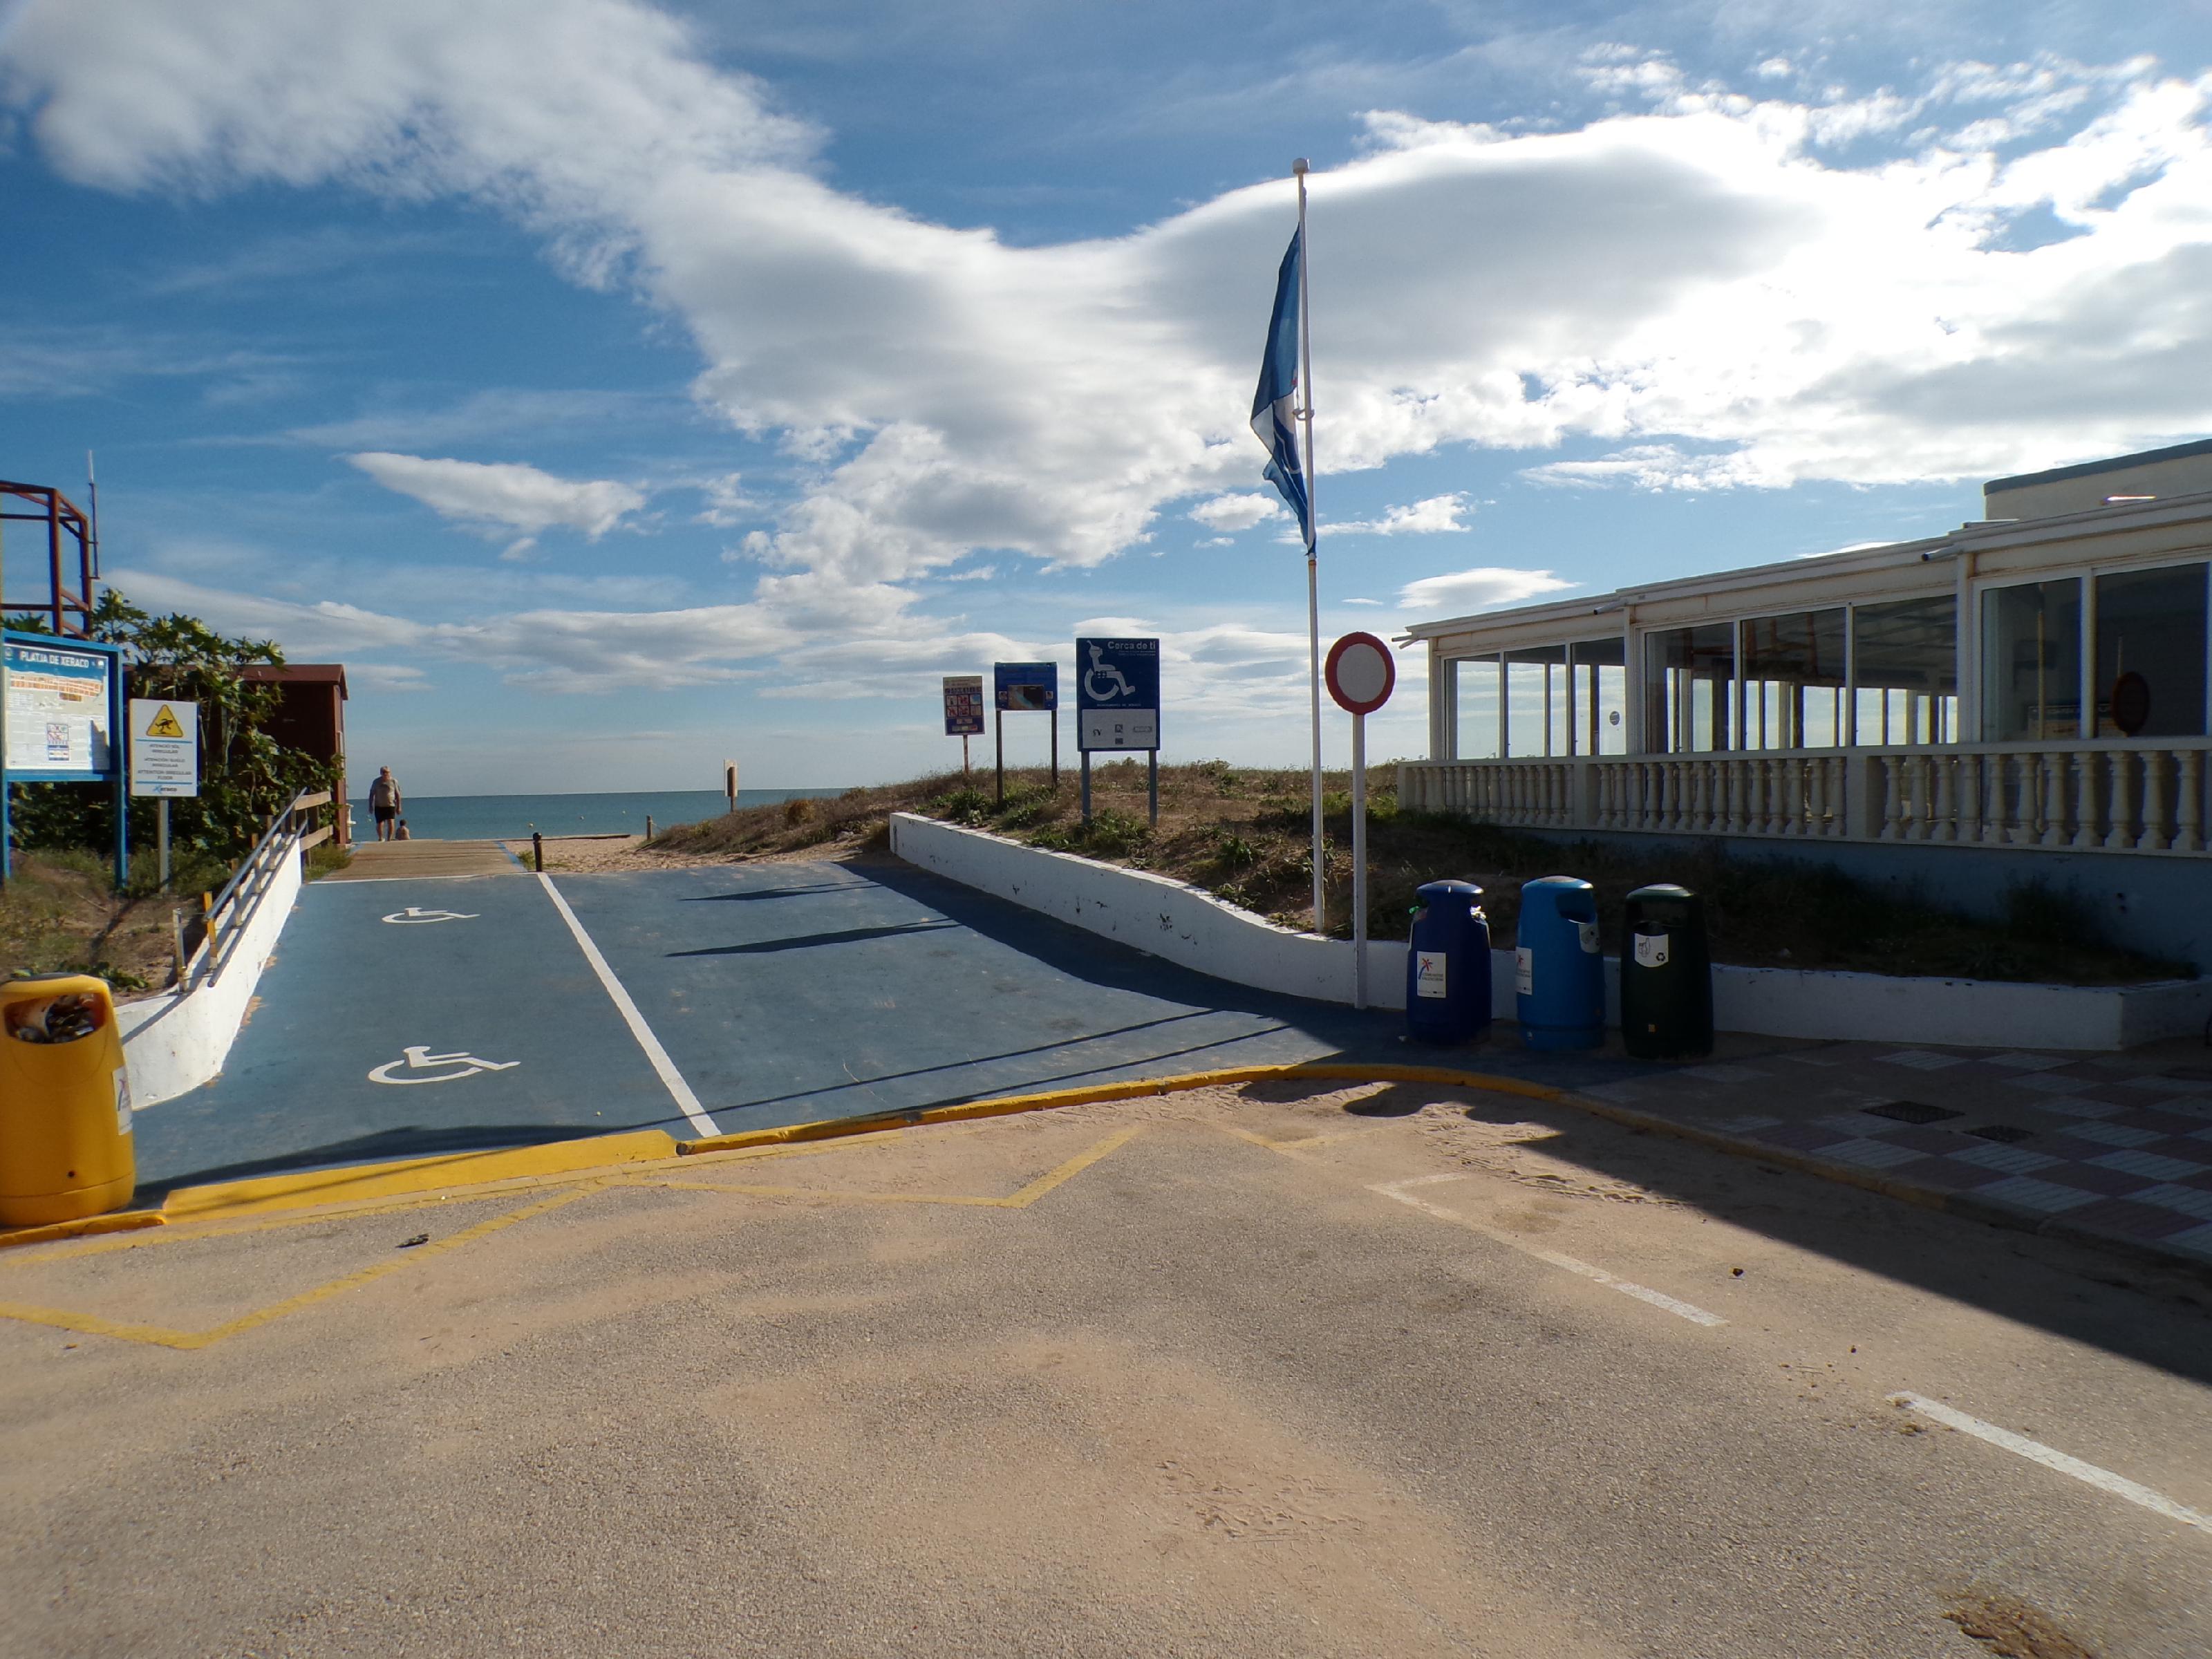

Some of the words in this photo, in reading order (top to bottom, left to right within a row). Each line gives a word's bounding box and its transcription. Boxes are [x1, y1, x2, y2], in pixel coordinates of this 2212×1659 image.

[1107, 641, 1134, 649] Cerca
[1150, 641, 1156, 649] ti
[49, 655, 59, 664] DE
